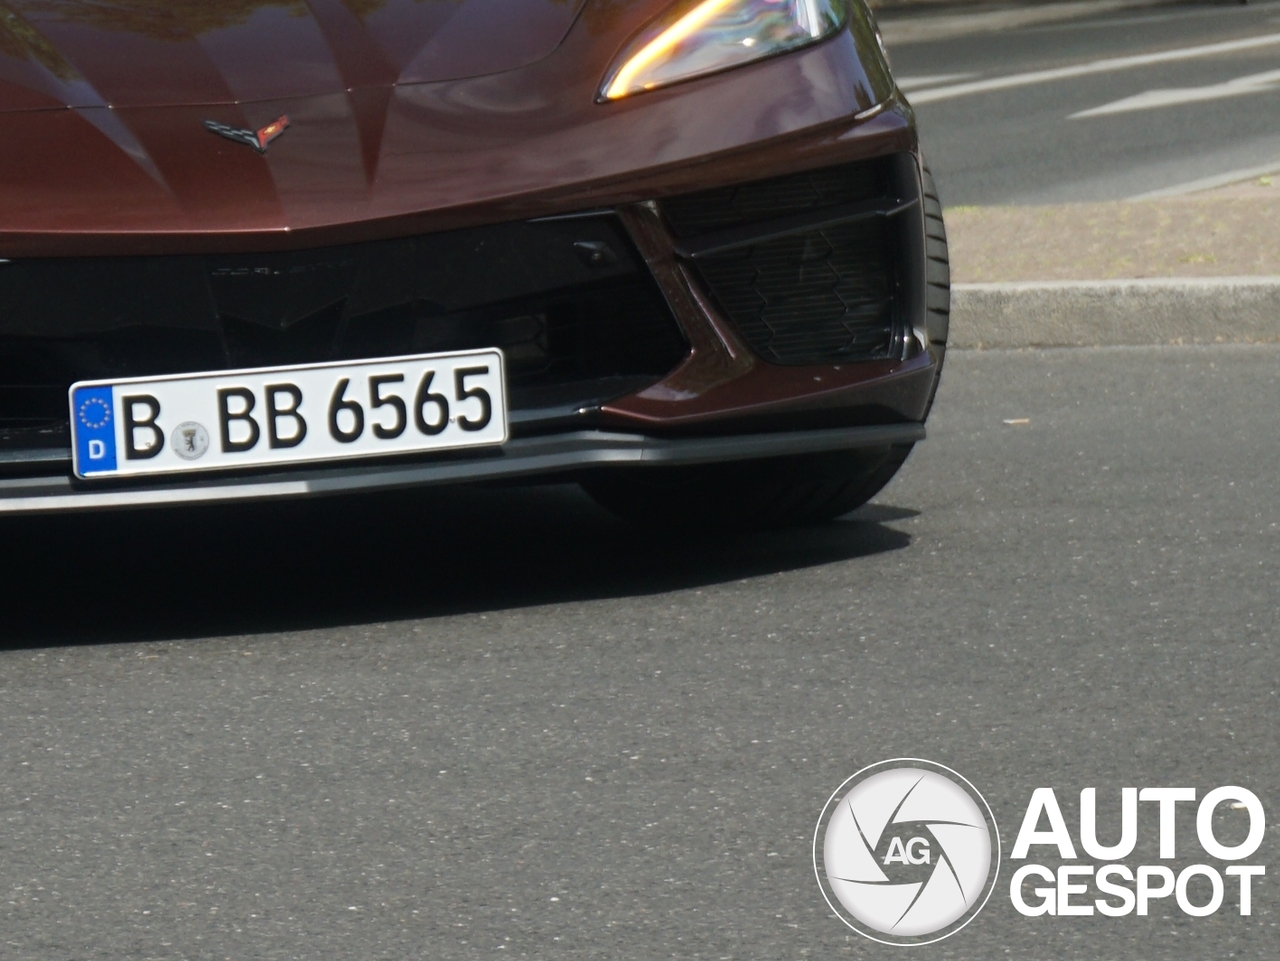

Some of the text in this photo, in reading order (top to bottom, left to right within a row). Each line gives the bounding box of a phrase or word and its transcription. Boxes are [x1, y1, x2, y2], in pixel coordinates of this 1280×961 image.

[121, 393, 165, 461] B
[216, 382, 308, 454] BB
[327, 365, 493, 444] 6565
[89, 438, 105, 460] D
